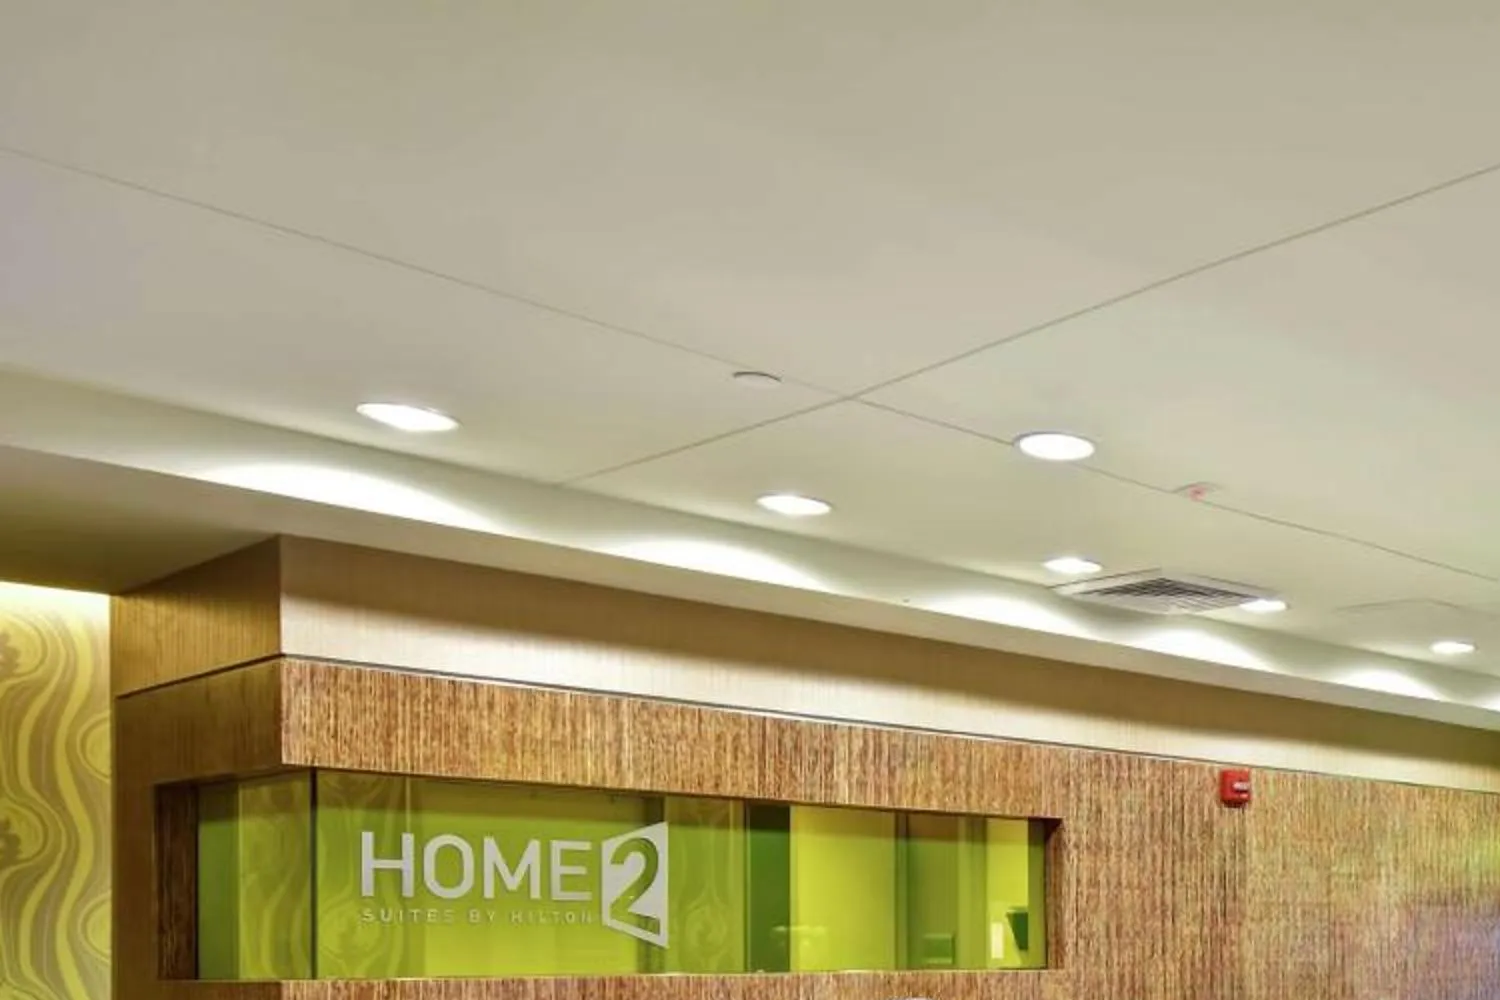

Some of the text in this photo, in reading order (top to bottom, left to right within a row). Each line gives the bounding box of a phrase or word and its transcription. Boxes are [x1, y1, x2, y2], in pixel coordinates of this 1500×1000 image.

[360, 830, 593, 901] HOME
[361, 908, 593, 924] SUITES BY HILTON
